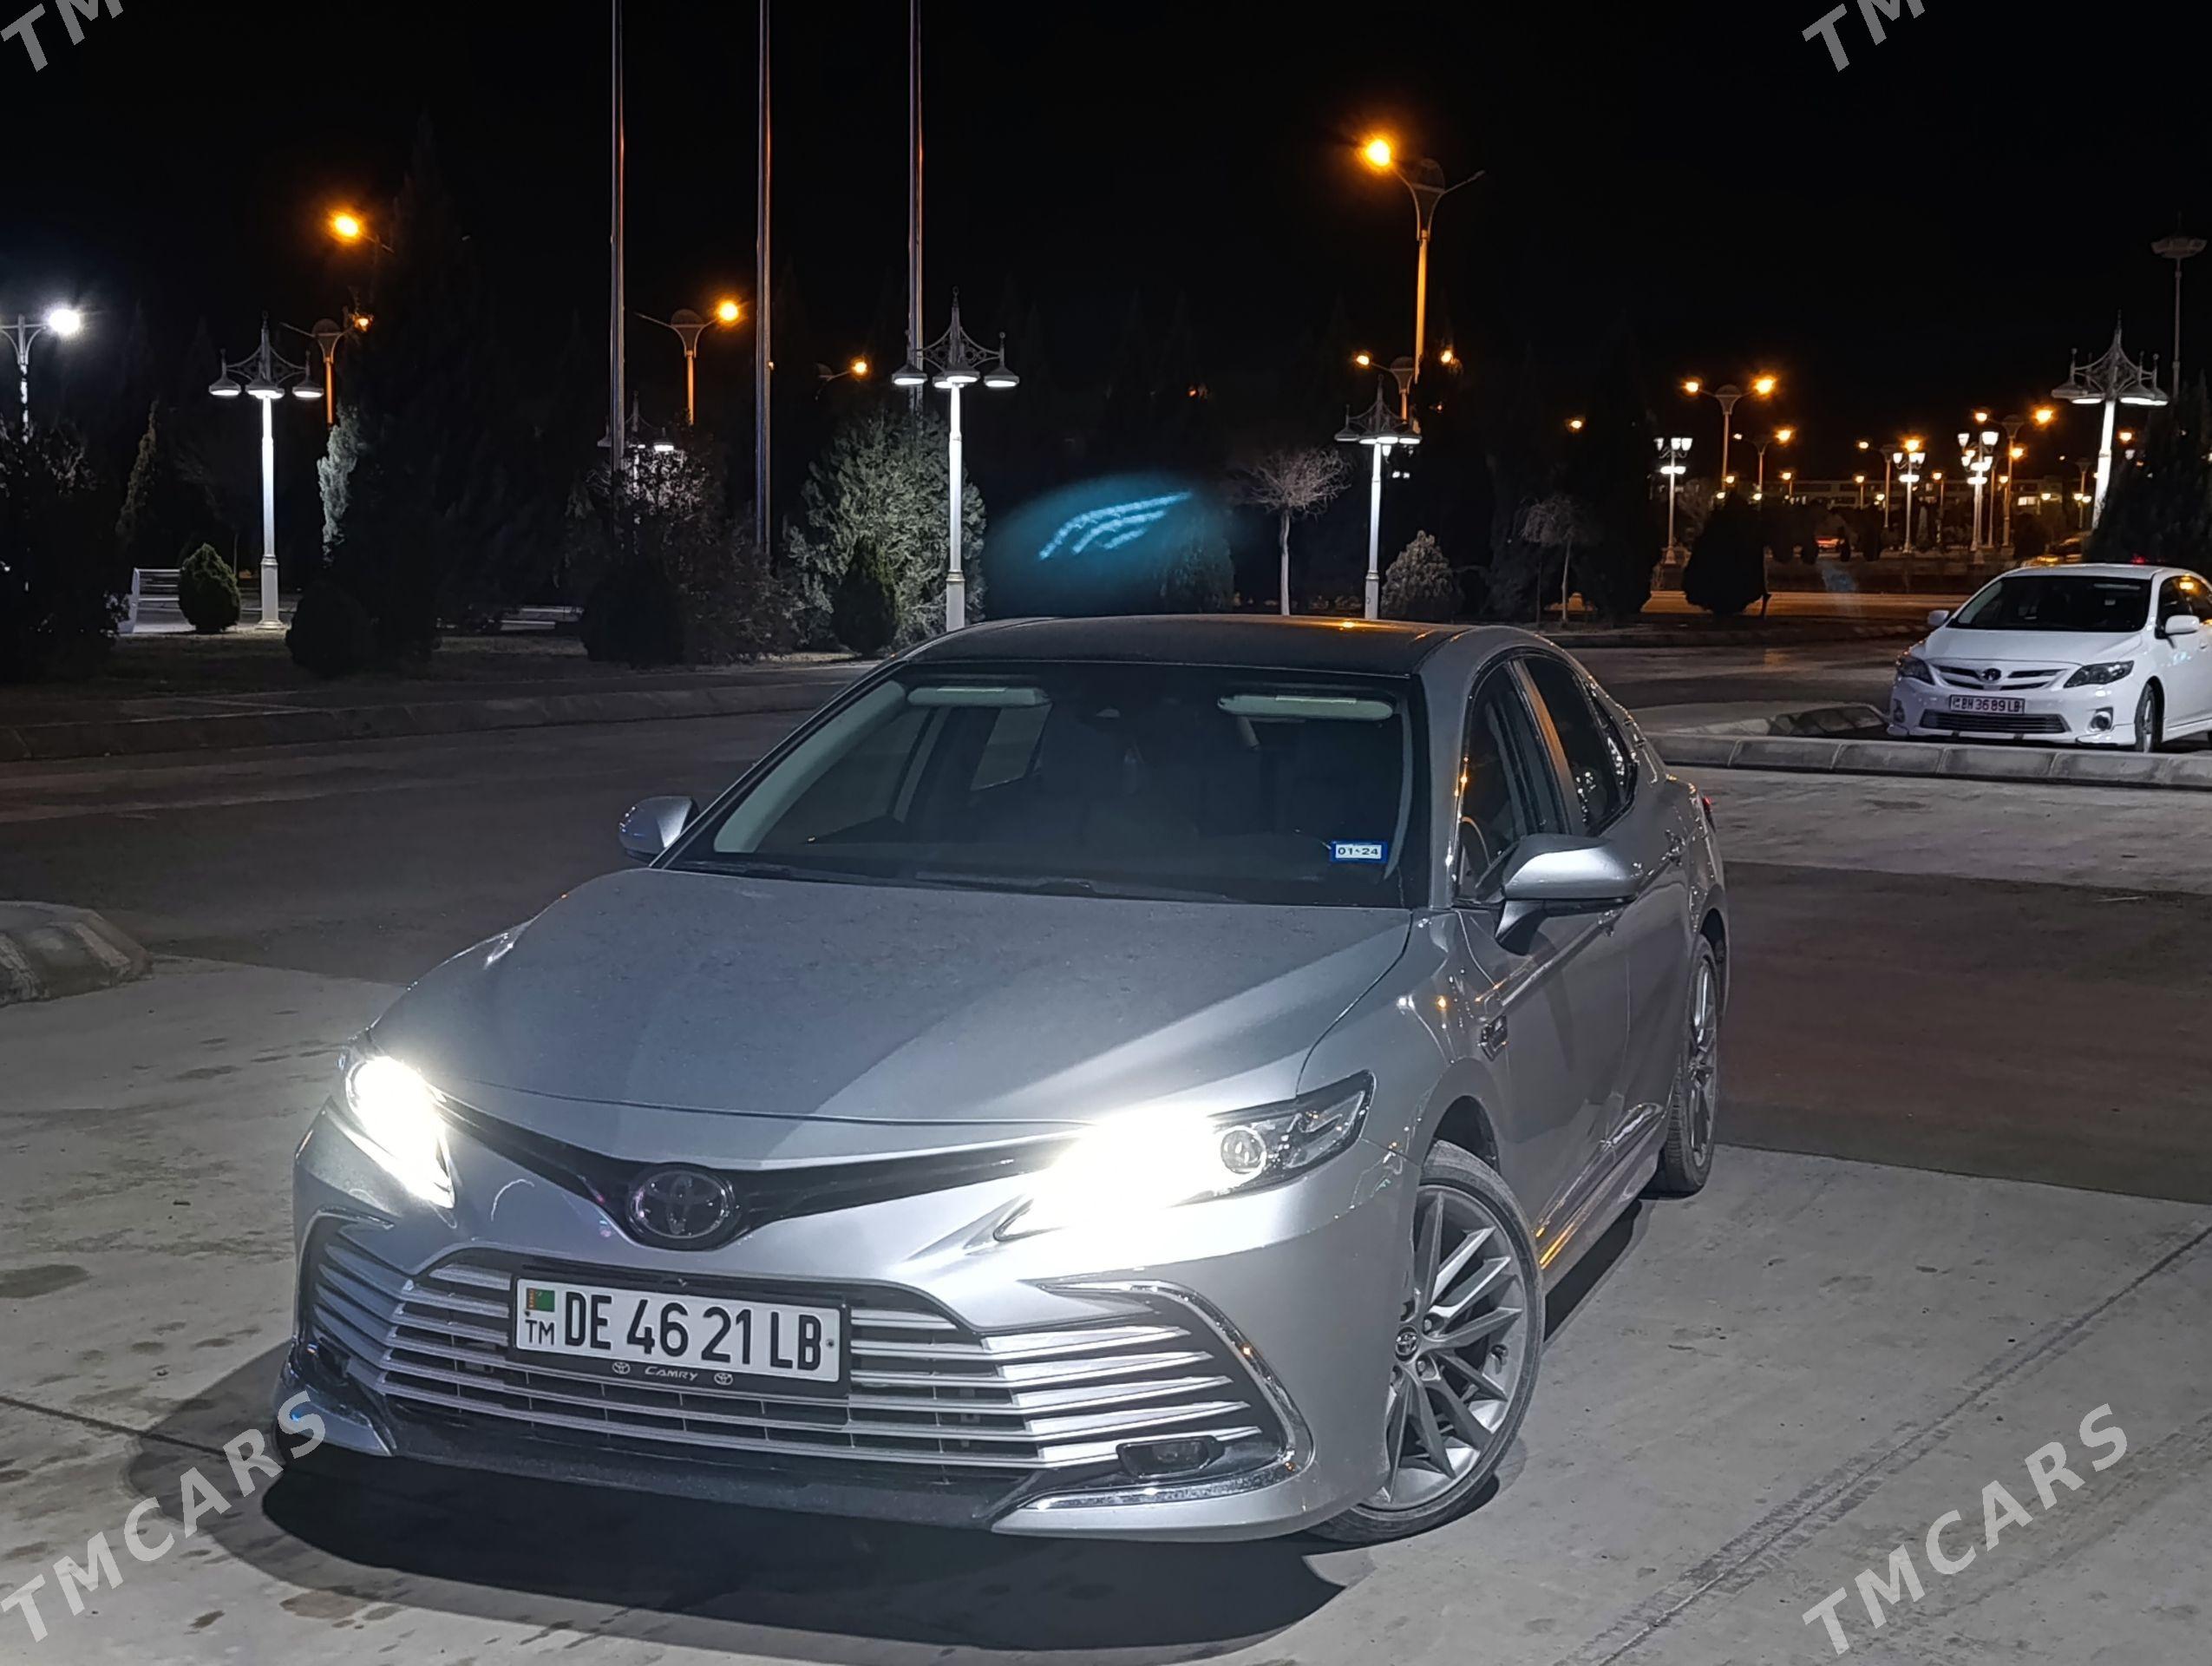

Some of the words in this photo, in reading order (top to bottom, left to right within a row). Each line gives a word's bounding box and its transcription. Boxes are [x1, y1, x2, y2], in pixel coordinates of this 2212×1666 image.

[525, 1319, 555, 1346] TM
[565, 1291, 612, 1351] DE
[770, 1312, 822, 1371] LB
[645, 1366, 698, 1381] CAMRY
